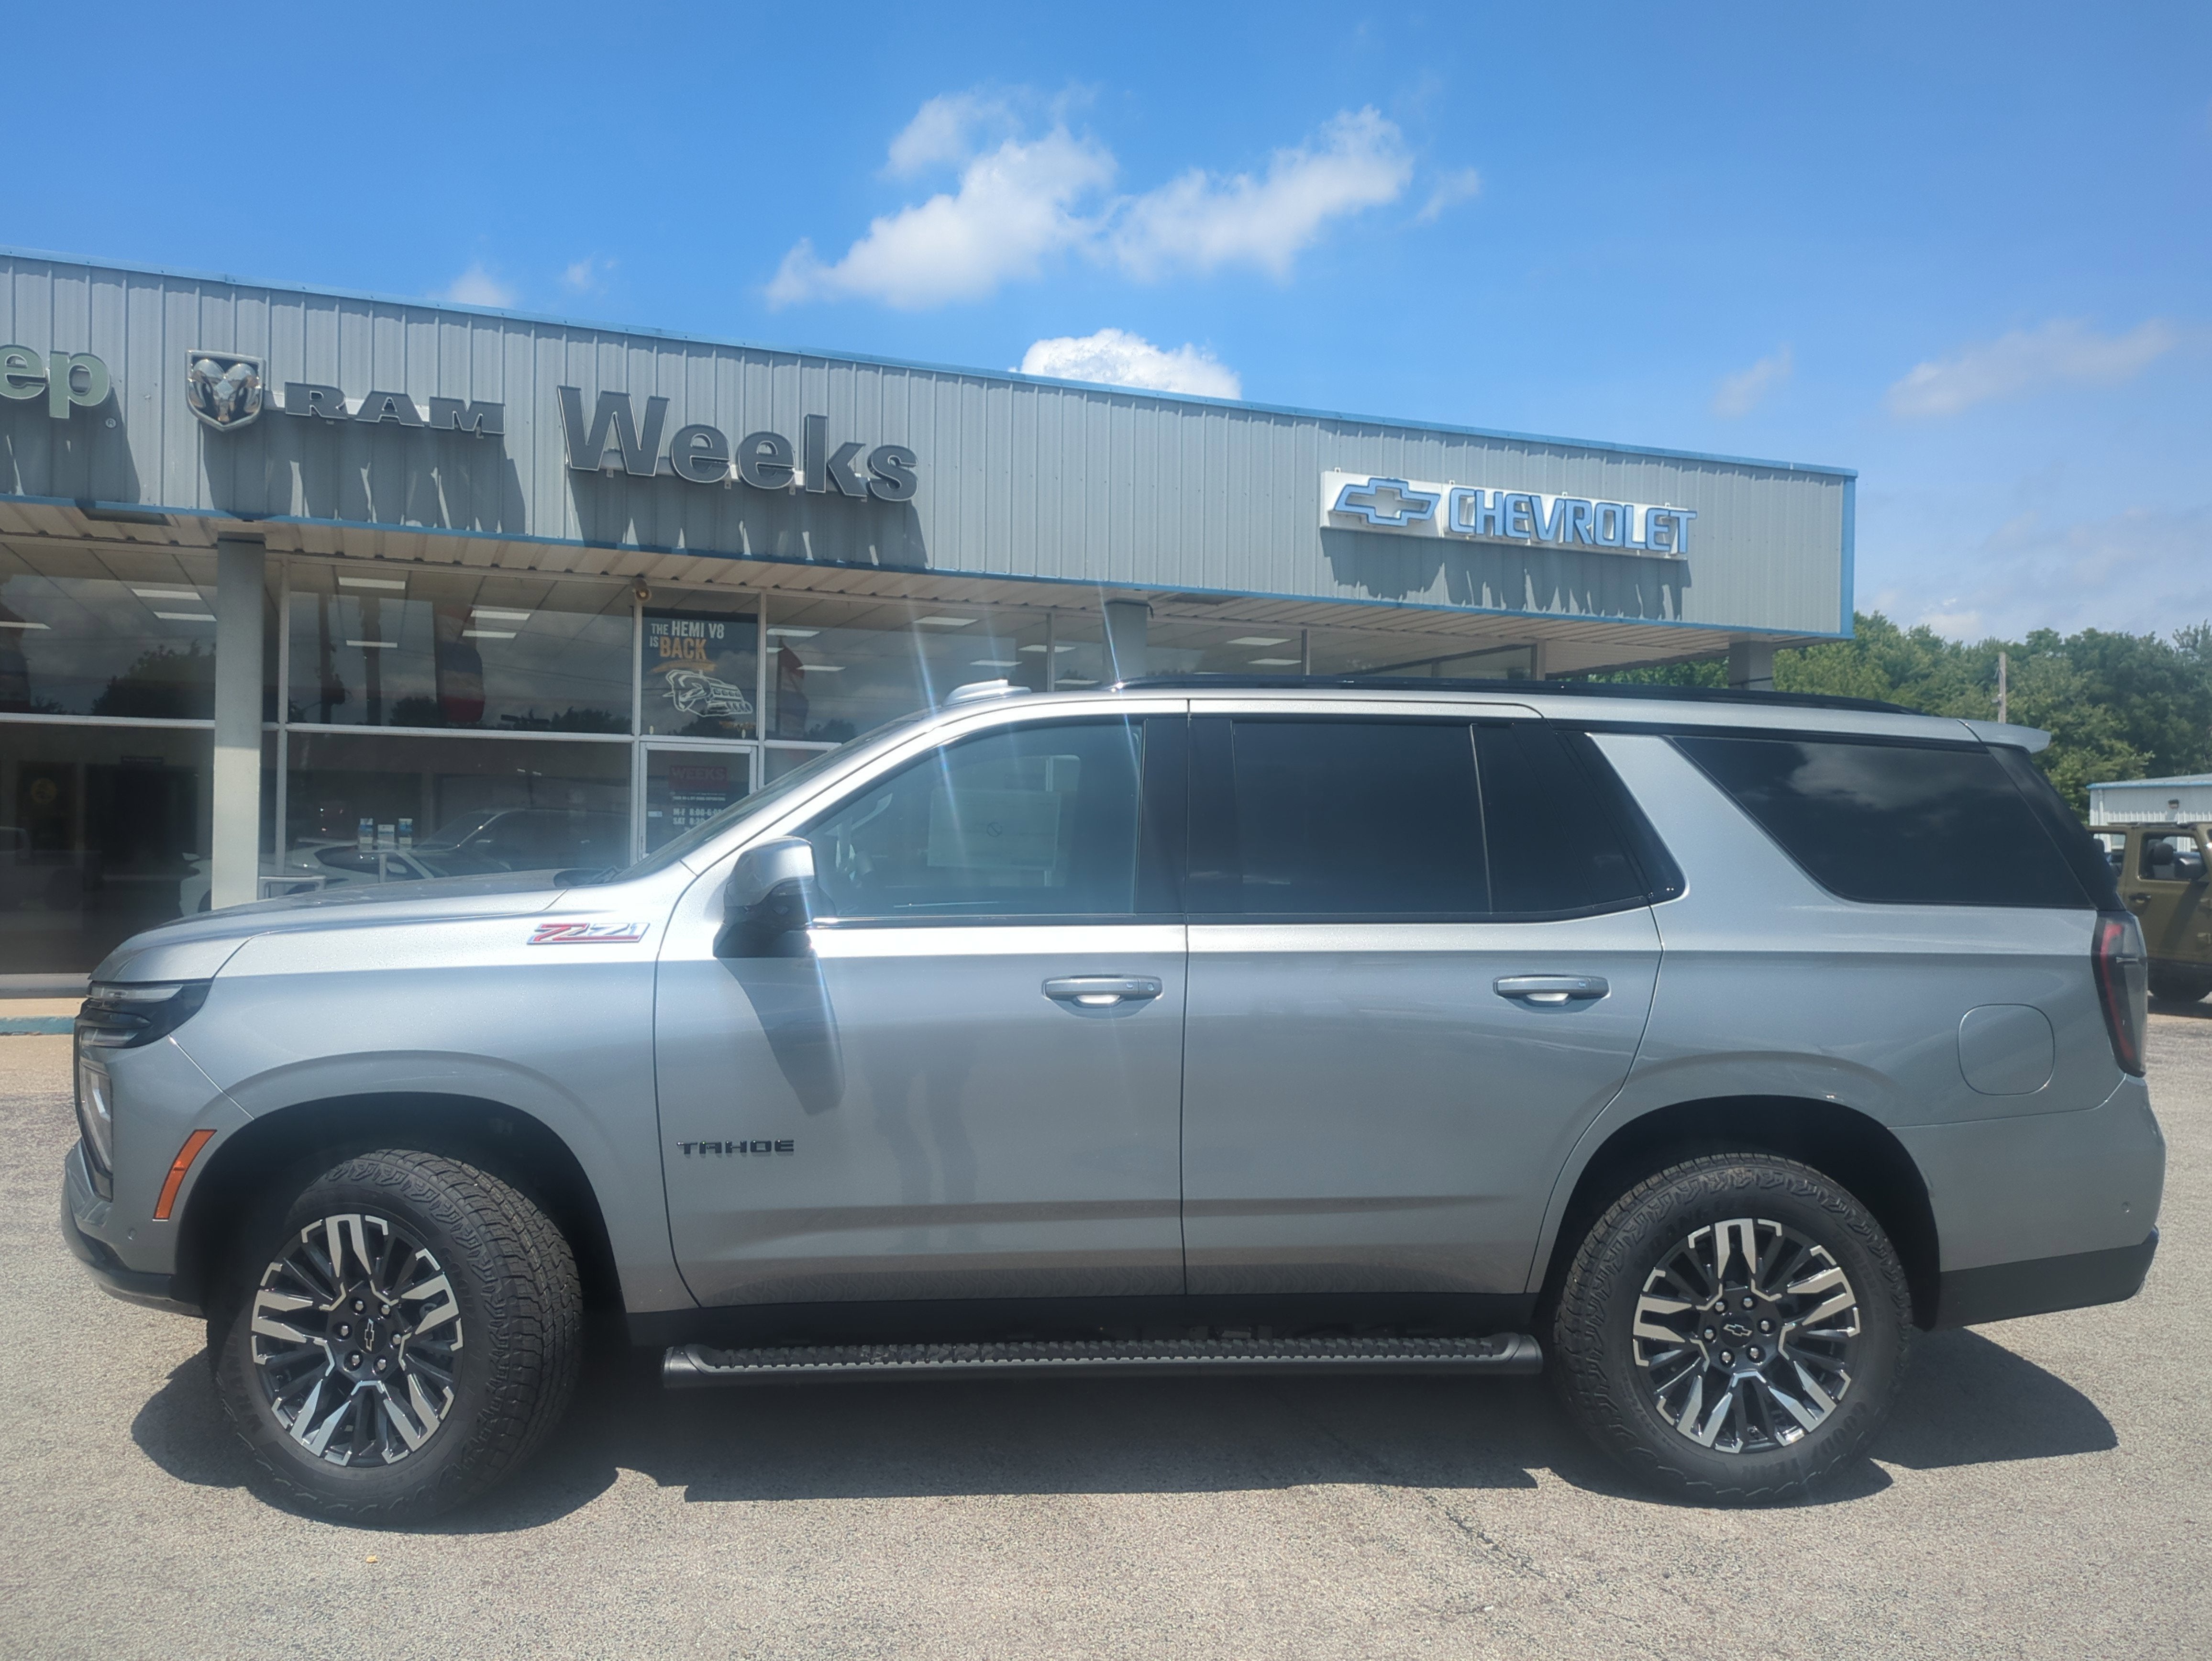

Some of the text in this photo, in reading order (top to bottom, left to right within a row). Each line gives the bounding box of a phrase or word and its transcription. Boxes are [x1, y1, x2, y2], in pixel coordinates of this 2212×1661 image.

[285, 382, 506, 434] RAM
[557, 386, 918, 501] Weeks
[1449, 487, 1697, 553] CHEVROLET
[651, 621, 725, 639] THE HEMI V8
[650, 636, 707, 660] IS BACK
[671, 767, 725, 780] WEEKS
[527, 922, 650, 945] Z71
[677, 1140, 794, 1154] TAHOE
